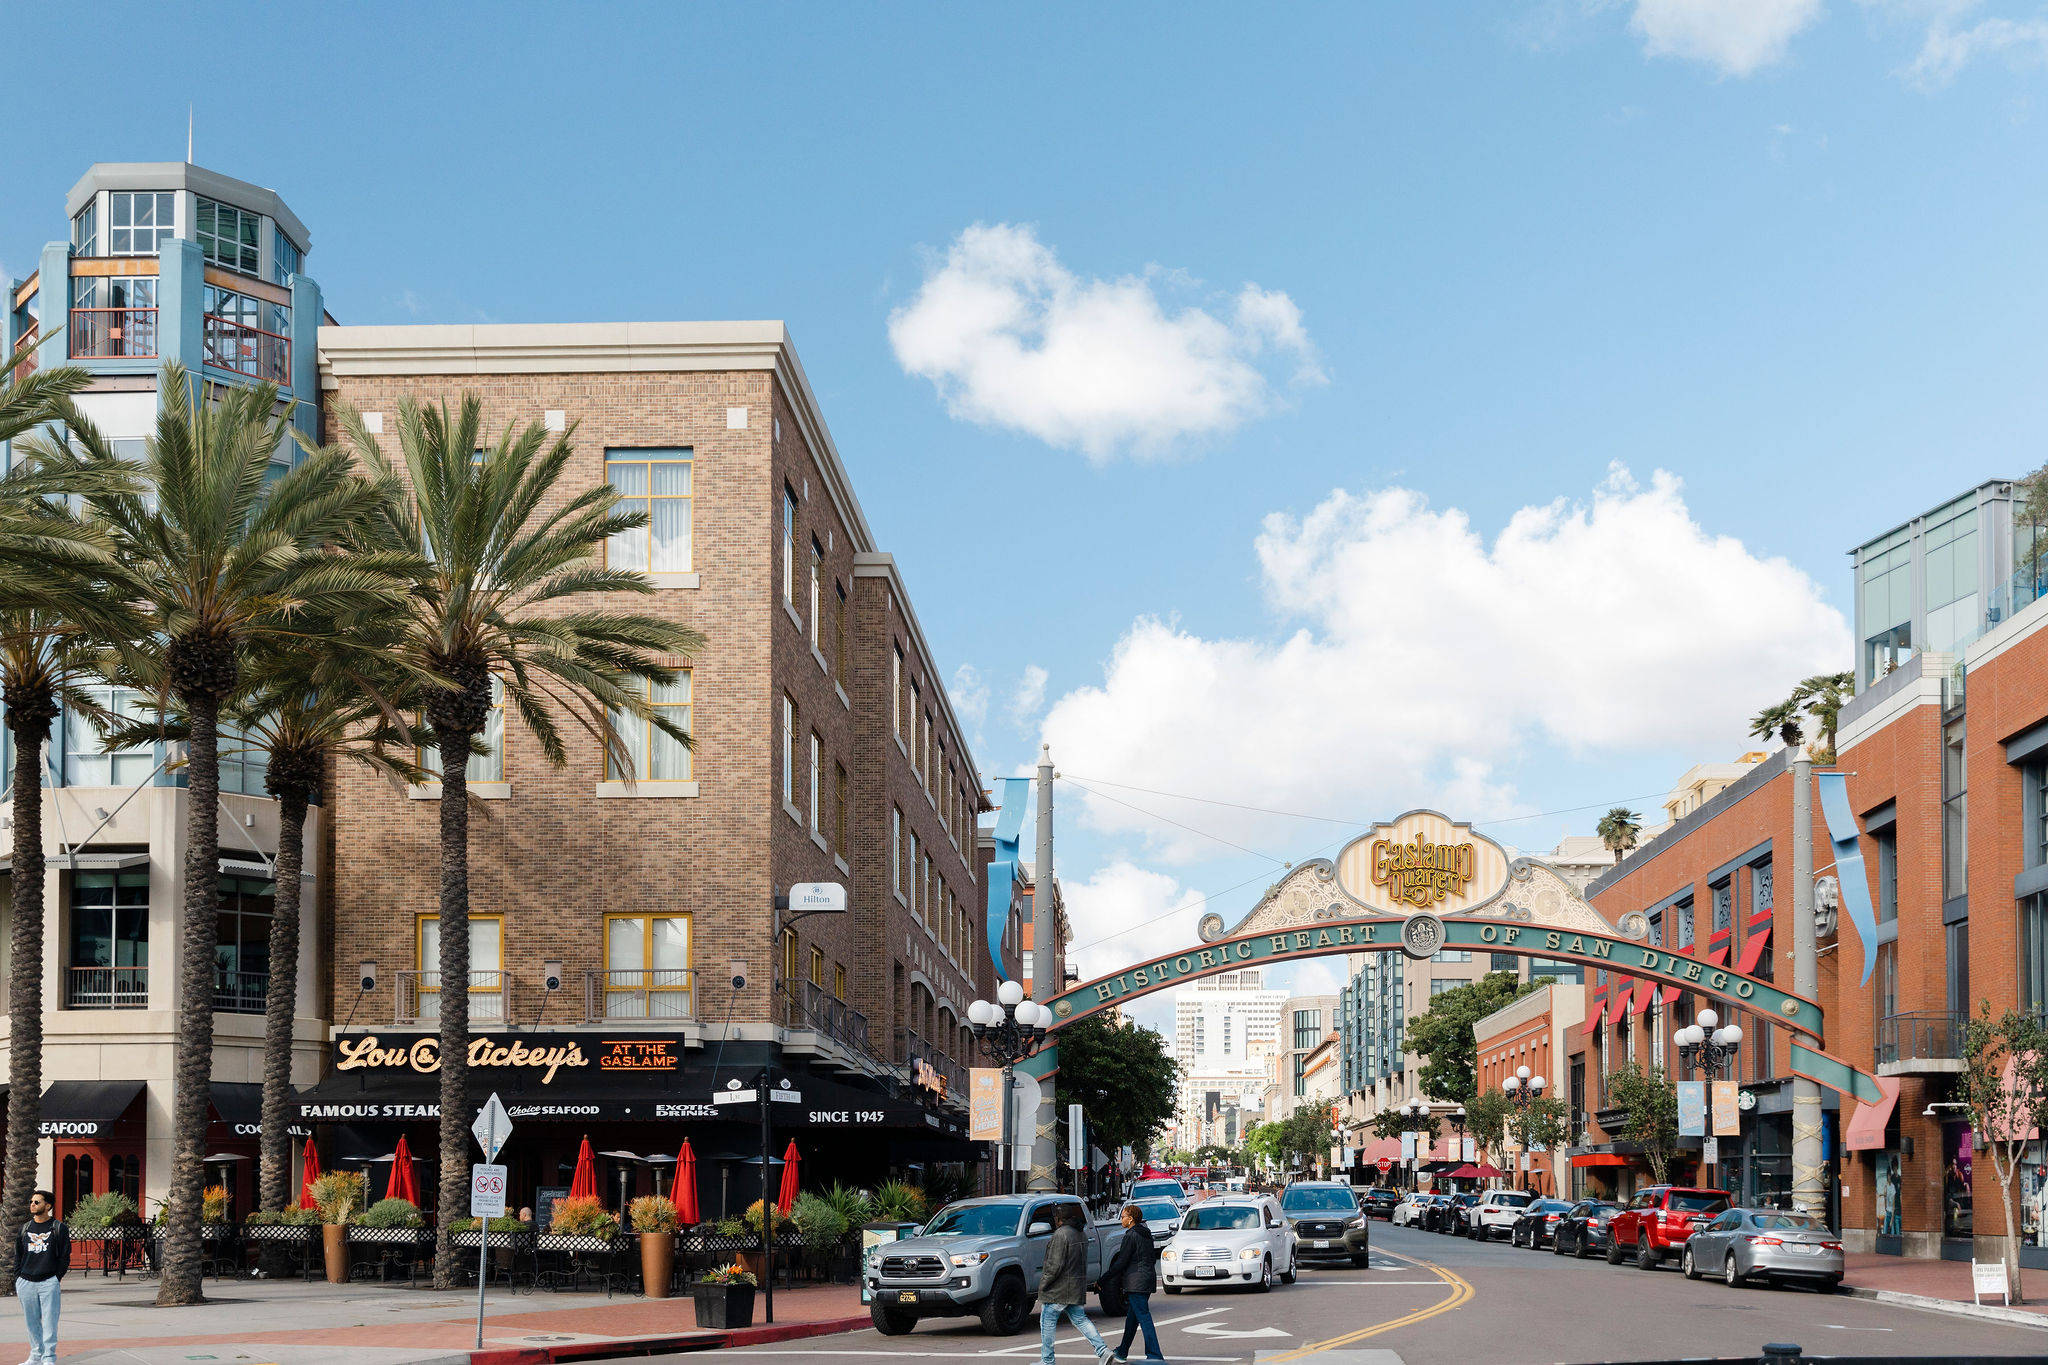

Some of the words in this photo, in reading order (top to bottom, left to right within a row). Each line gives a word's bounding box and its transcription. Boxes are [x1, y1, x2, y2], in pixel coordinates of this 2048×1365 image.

[1371, 832, 1474, 896] Gaslamp
[1389, 869, 1461, 907] Quarter
[803, 895, 830, 903] Hilton
[1094, 941, 1252, 1002] HISTORIC
[1269, 925, 1376, 954] HEART
[1480, 925, 1521, 944] OF
[1545, 932, 1613, 958] SAN
[1639, 950, 1754, 998] DIEGO
[612, 1044, 631, 1055] AT
[636, 1044, 666, 1055] THE
[336, 1036, 408, 1071] Lou
[467, 1037, 589, 1084] ickey's
[600, 1056, 678, 1067] GASLAMP
[300, 1105, 379, 1117] FAMOUS
[507, 1105, 541, 1116] Choice
[541, 1105, 600, 1115] SEAFOOD
[809, 1111, 849, 1123] SINCE
[855, 1111, 885, 1123] 1945
[38, 1122, 98, 1134] EAFOOD
